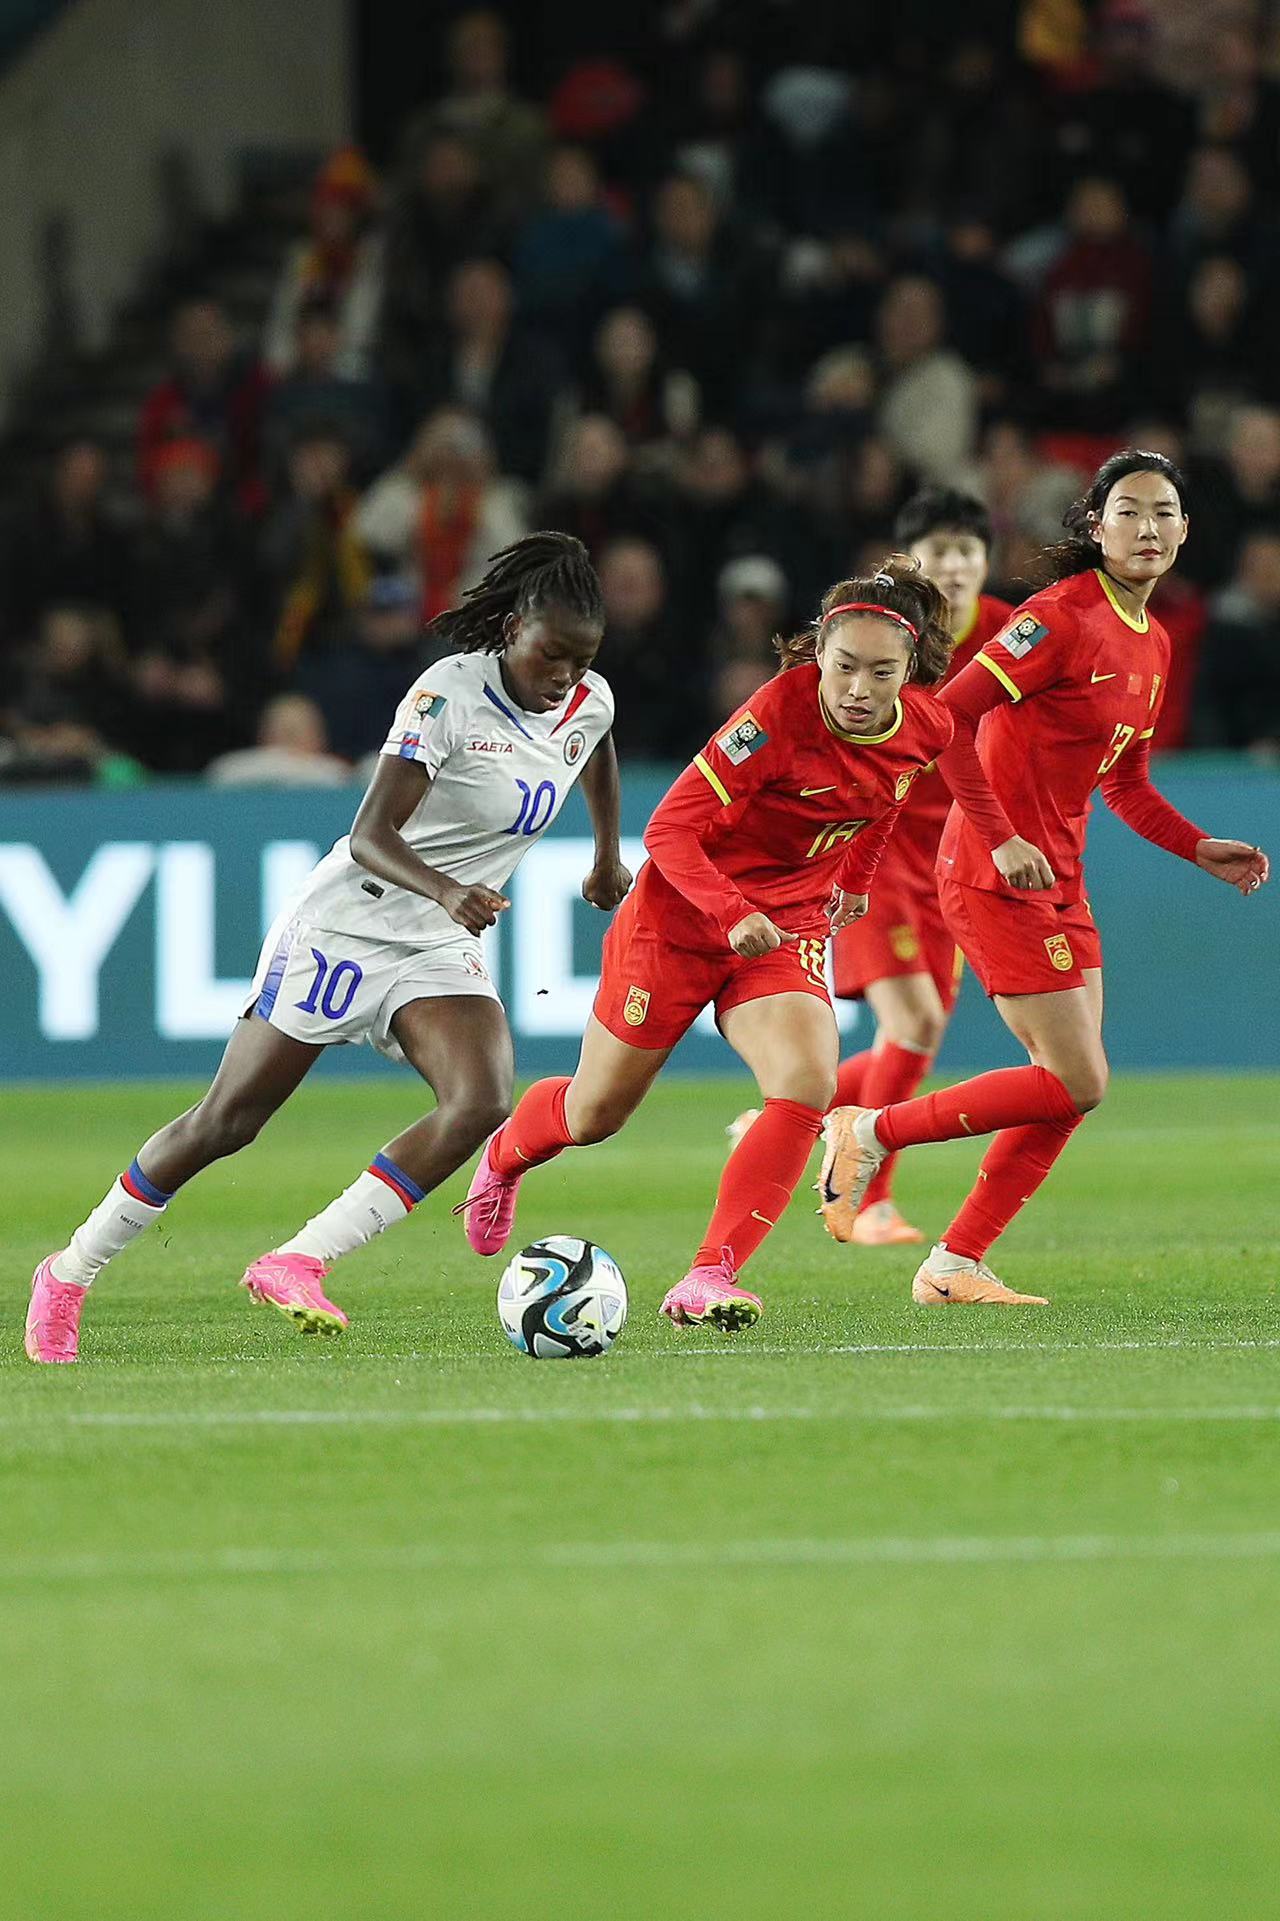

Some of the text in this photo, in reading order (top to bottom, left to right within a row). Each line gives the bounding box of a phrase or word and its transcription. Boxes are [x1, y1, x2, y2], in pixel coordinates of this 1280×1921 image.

[466, 740, 513, 753] SAETA
[500, 778, 557, 836] 10
[292, 946, 363, 1020] 10
